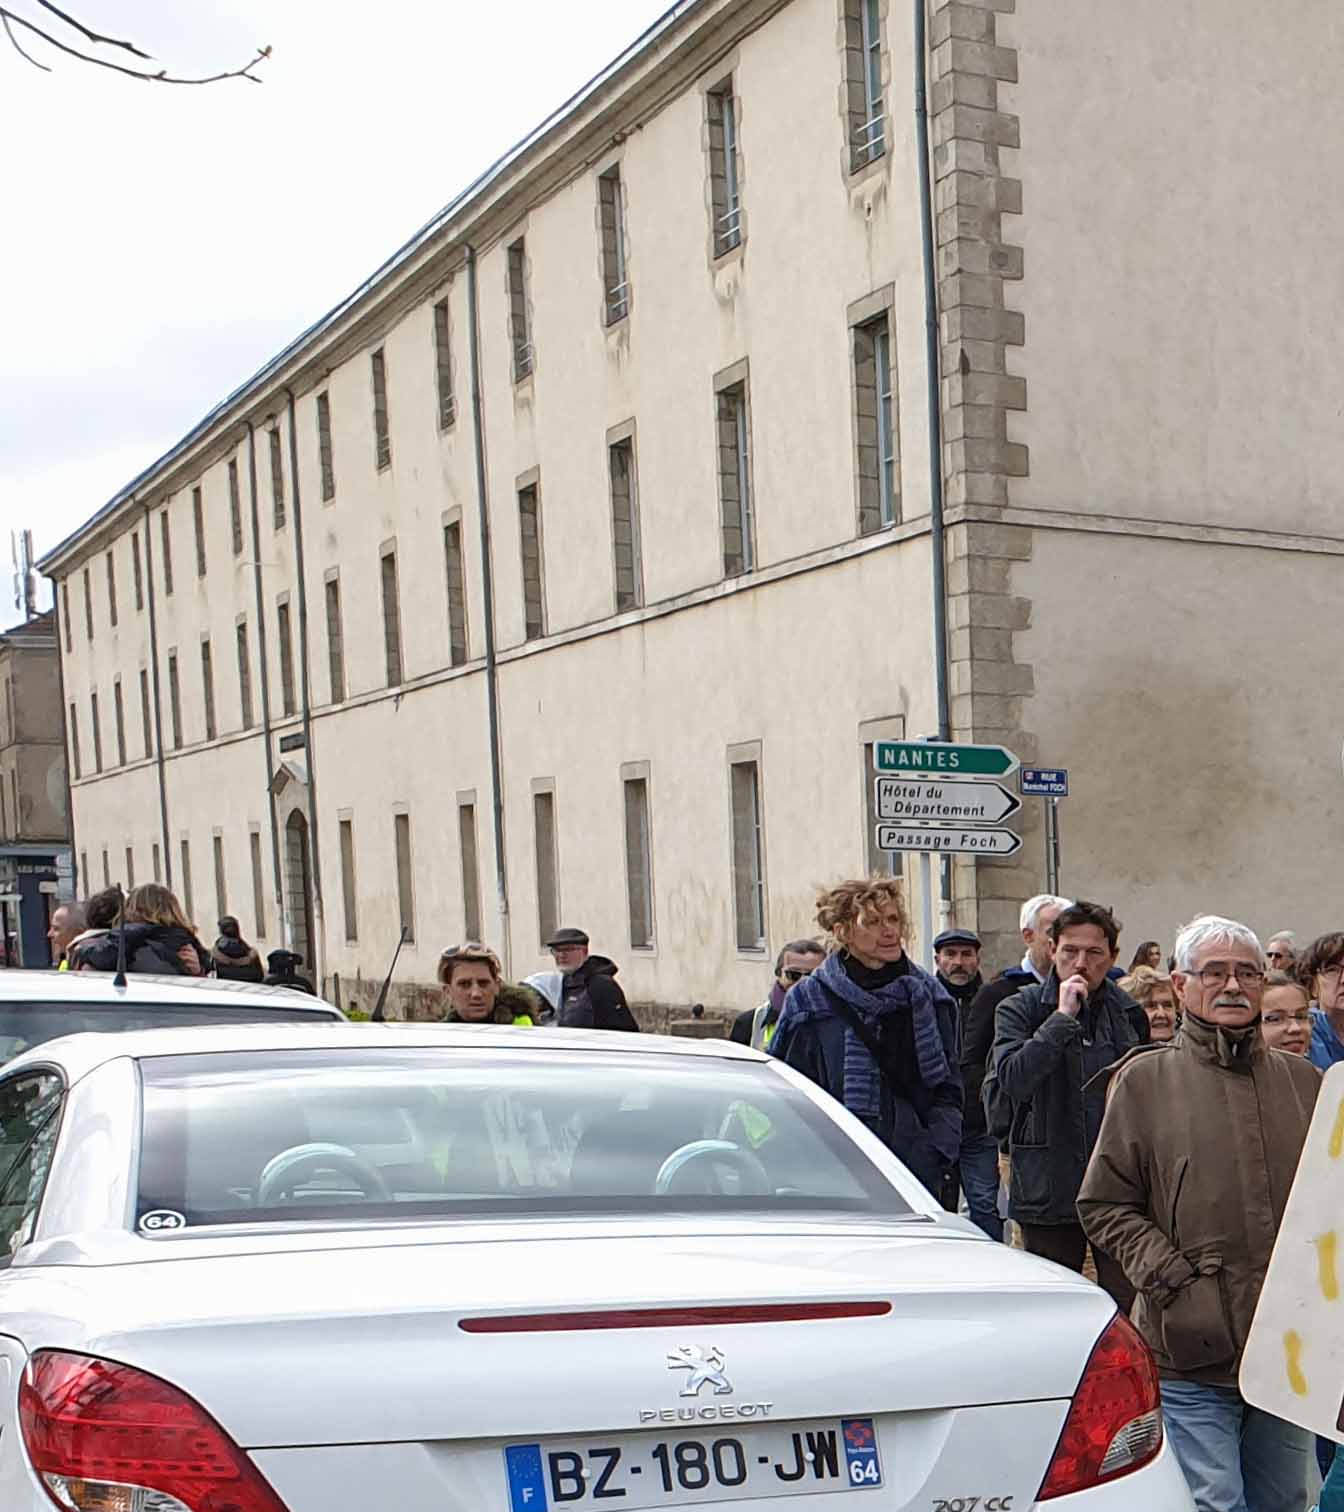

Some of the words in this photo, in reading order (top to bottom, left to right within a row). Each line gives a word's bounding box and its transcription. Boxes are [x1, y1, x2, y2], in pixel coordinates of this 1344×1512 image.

[884, 749, 960, 768] NANTES
[883, 785, 921, 798] Hôtel
[926, 786, 943, 799] du
[894, 801, 985, 817] Département
[886, 832, 951, 849] Passage
[960, 834, 997, 848] Foch
[147, 1216, 178, 1229] 64
[639, 1402, 774, 1423] PEUGEOT
[850, 1459, 879, 1484] 64
[522, 1488, 534, 1504] F
